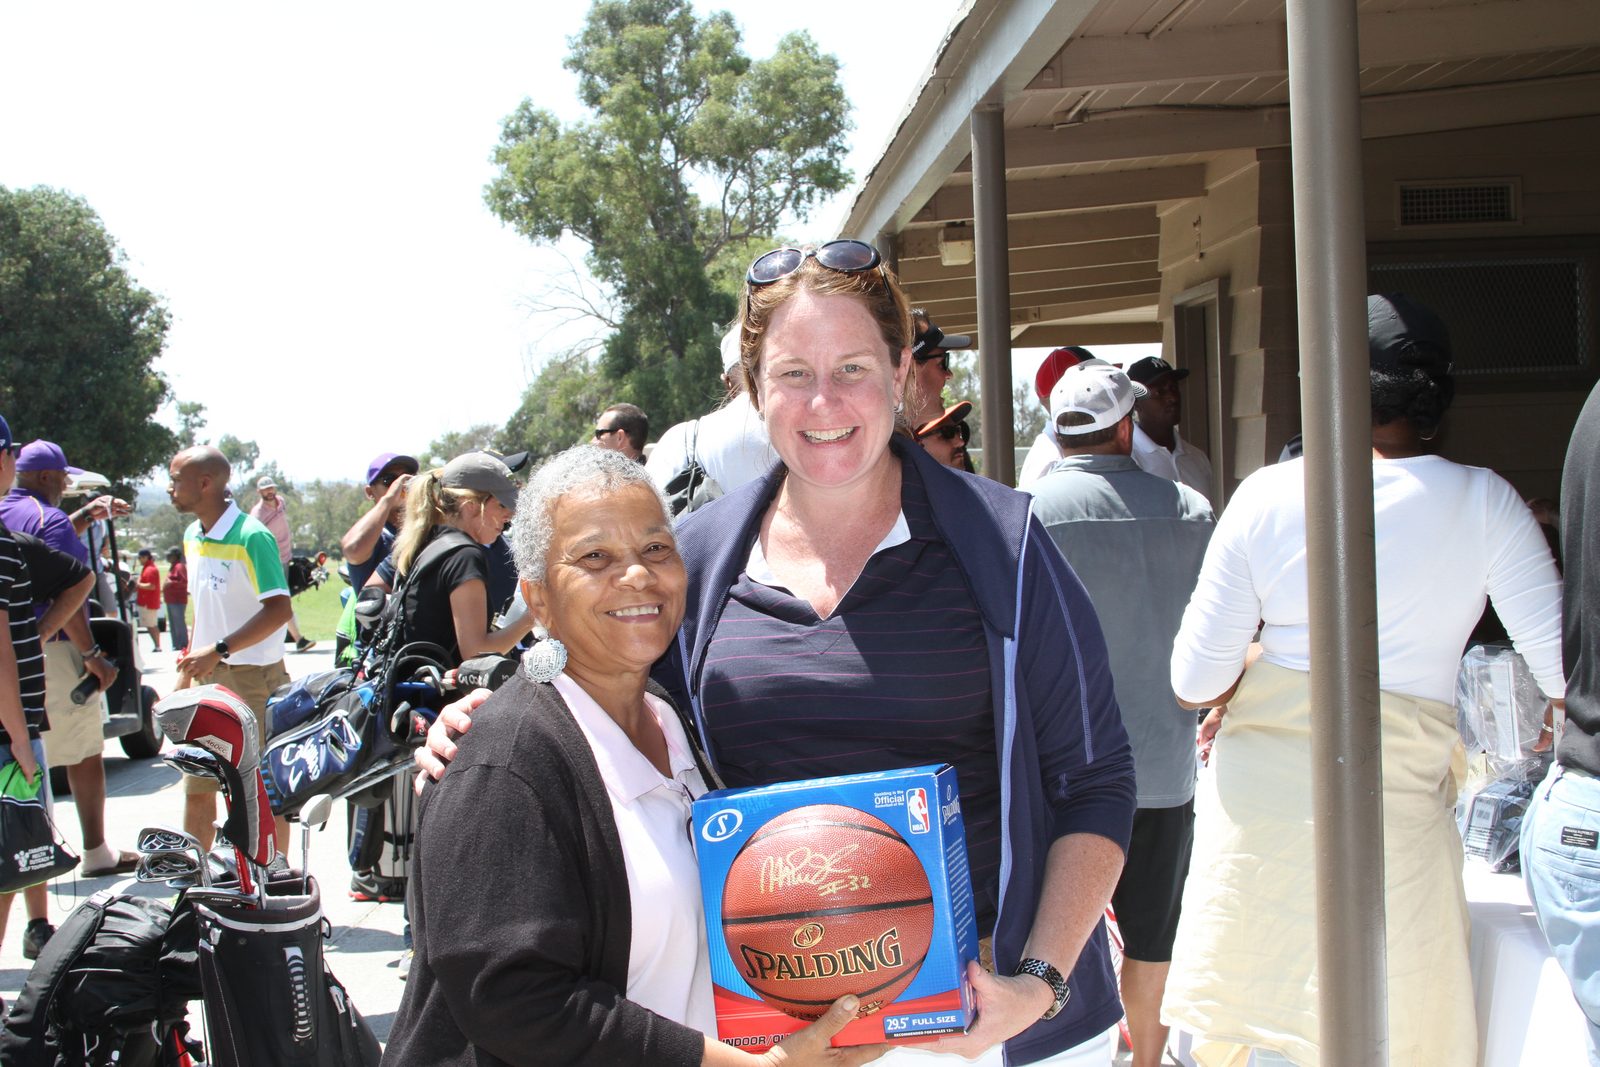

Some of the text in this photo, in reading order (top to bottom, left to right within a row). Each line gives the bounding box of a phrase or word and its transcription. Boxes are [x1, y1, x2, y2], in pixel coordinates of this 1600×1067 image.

[874, 794, 905, 805] Official
[912, 823, 925, 831] NBA
[740, 927, 903, 981] SPALDING
[912, 1017, 935, 1026] FULL
[936, 1015, 957, 1024] SIZE
